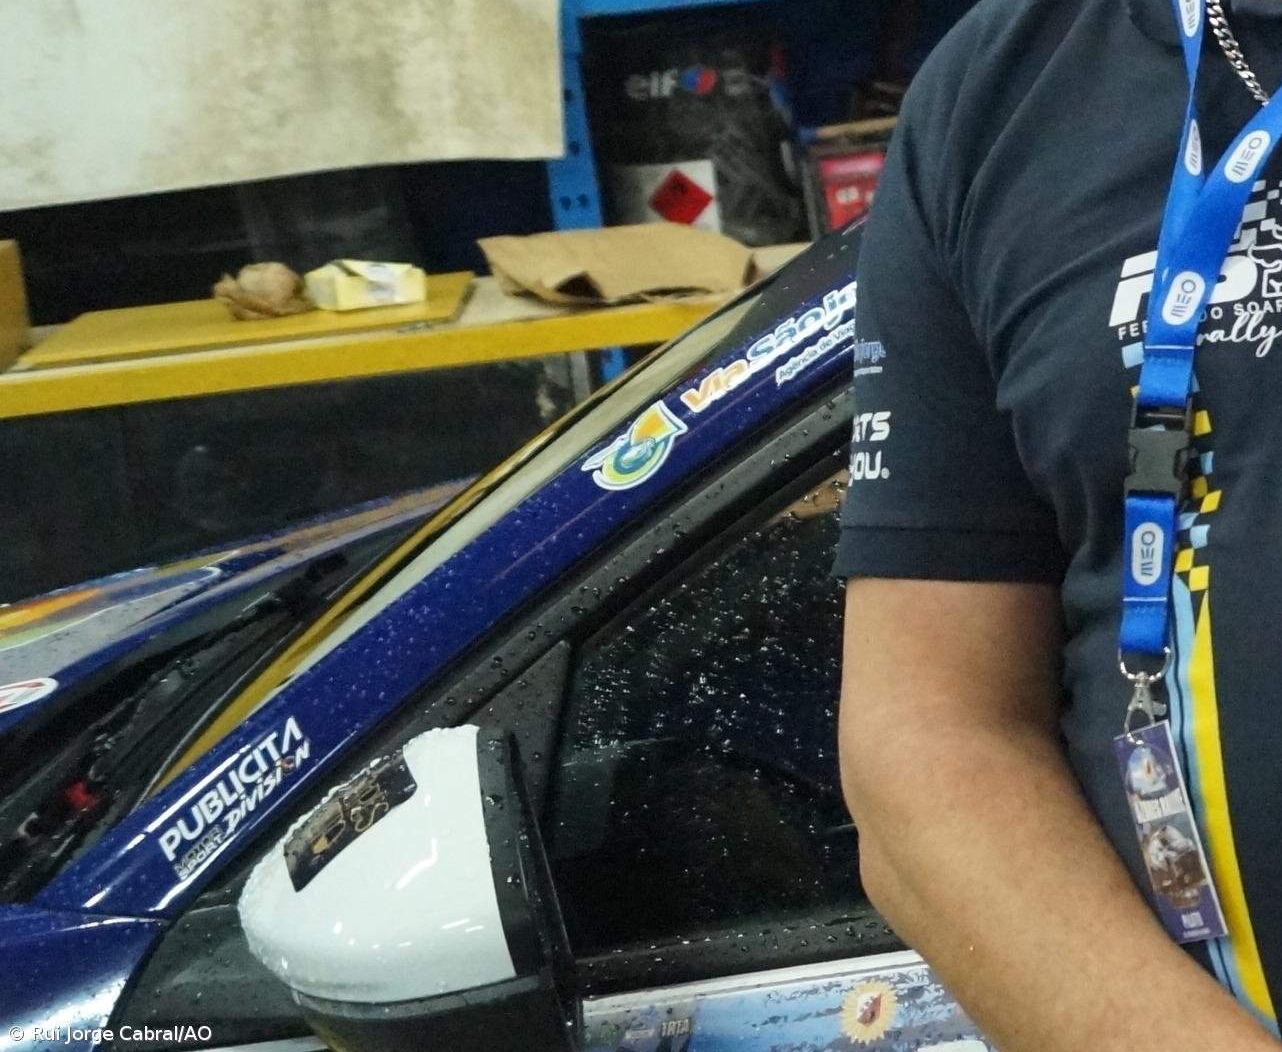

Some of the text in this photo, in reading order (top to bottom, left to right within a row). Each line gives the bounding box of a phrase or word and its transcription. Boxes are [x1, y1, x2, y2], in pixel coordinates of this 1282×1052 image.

[1231, 136, 1263, 177] MEO
[1170, 278, 1197, 318] MEO
[1140, 530, 1156, 577] MEO
